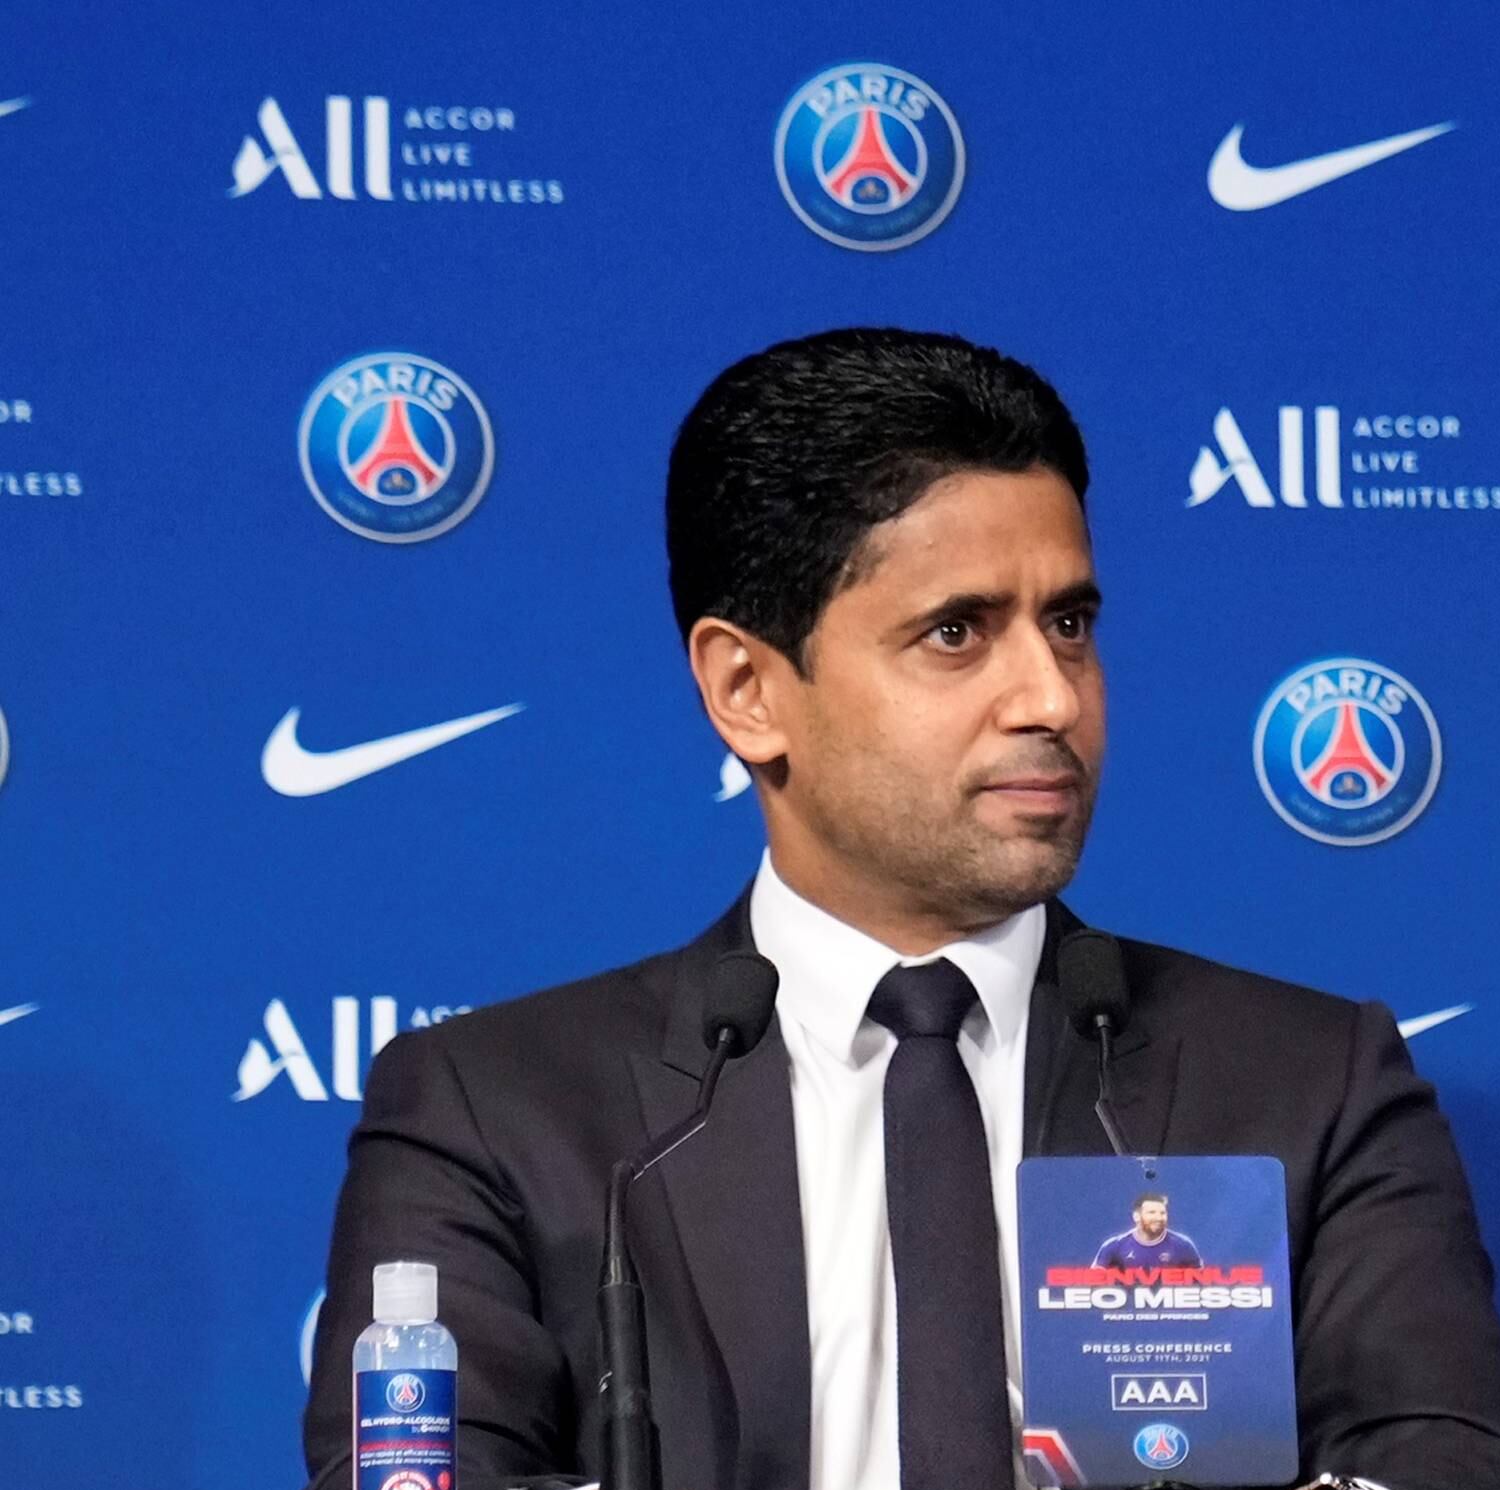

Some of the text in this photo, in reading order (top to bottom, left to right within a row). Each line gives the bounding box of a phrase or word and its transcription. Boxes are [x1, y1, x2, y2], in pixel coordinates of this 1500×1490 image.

[806, 75, 929, 122] PARIS
[404, 107, 515, 131] ACCOR
[402, 143, 470, 167] LIVE
[402, 178, 564, 204] LIMITLESS
[331, 364, 457, 412] PARIS
[1353, 415, 1460, 439] ACCOR
[1351, 450, 1417, 474] LIVE
[1284, 670, 1406, 717] PARIS
[1046, 1266, 1263, 1286] BIENVENUE
[1038, 1287, 1272, 1309] LEO MESSI
[1082, 1342, 1232, 1354] PRESS CONFERENCE
[1105, 1354, 1151, 1363] AUGUST
[1185, 1354, 1211, 1362] 2021
[1120, 1380, 1198, 1404] AAA
